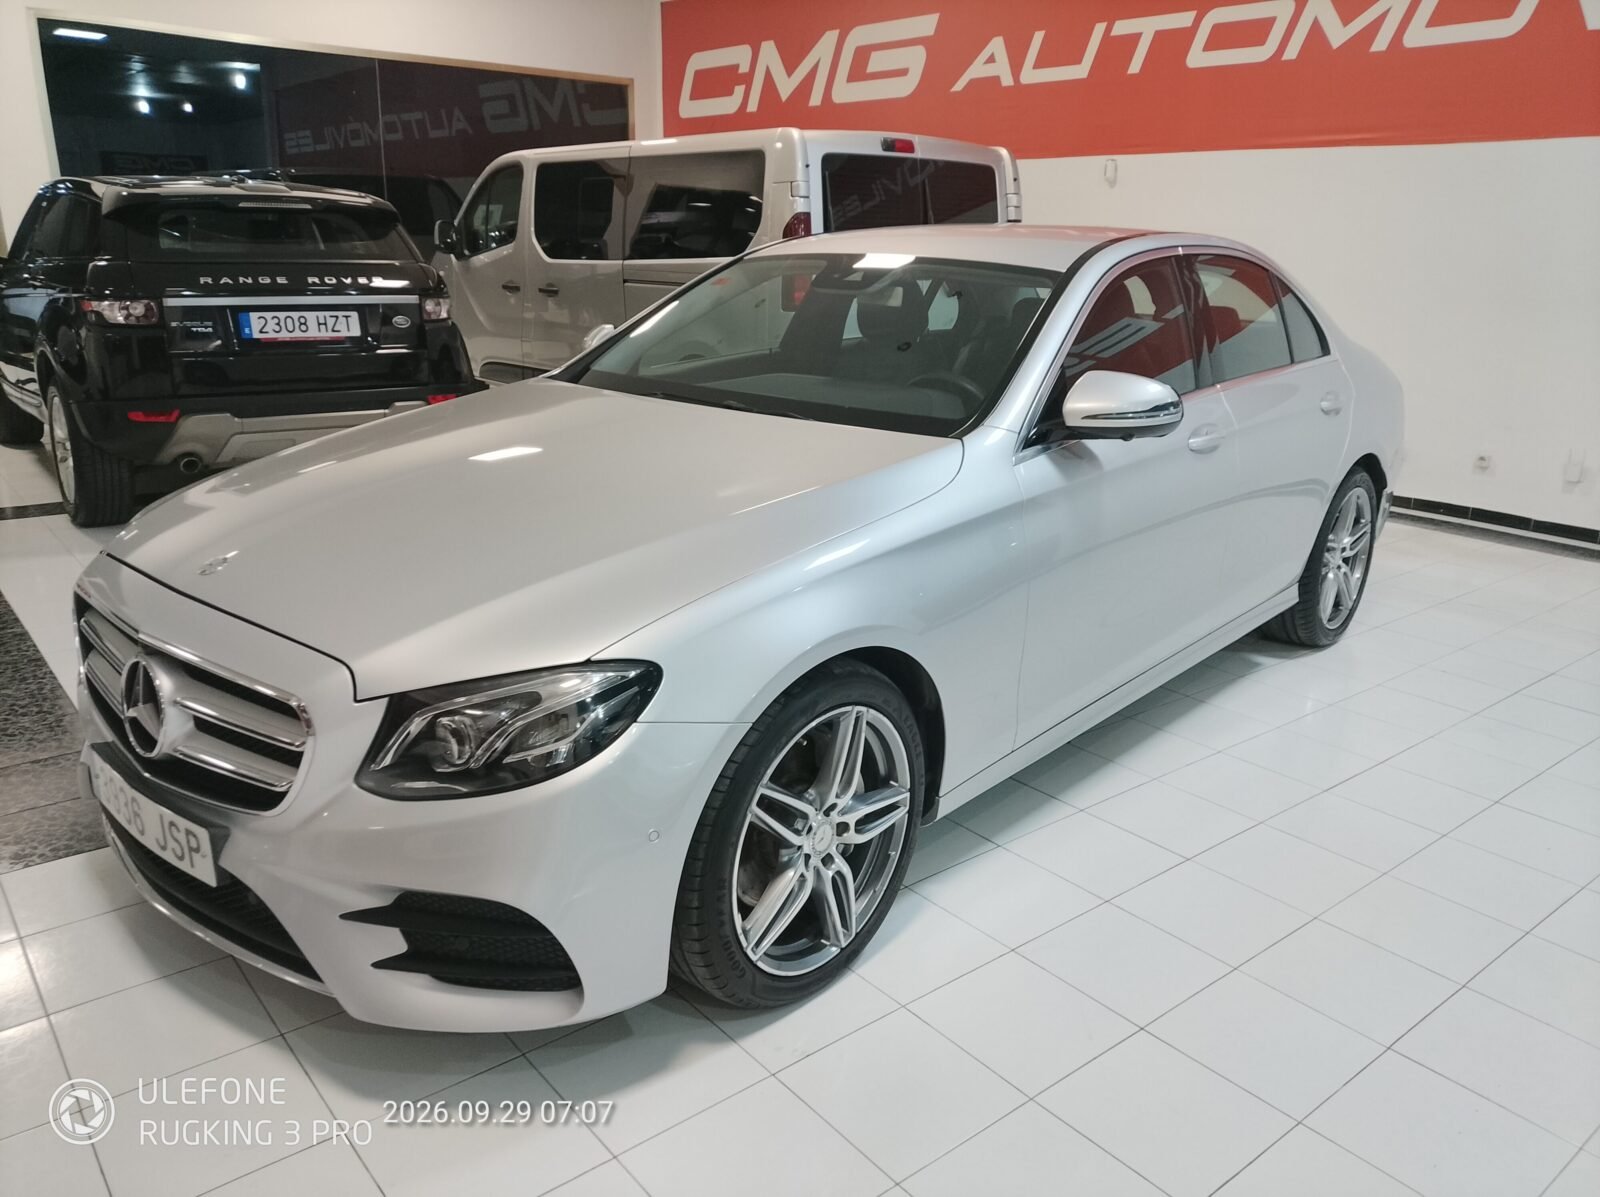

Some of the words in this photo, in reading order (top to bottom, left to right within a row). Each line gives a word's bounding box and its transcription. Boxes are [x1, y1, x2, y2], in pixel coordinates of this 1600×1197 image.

[678, 12, 941, 119] CMG
[199, 275, 289, 285] RANGE
[257, 315, 309, 334] 2308
[317, 314, 352, 333] HZT
[155, 813, 201, 869] JSP
